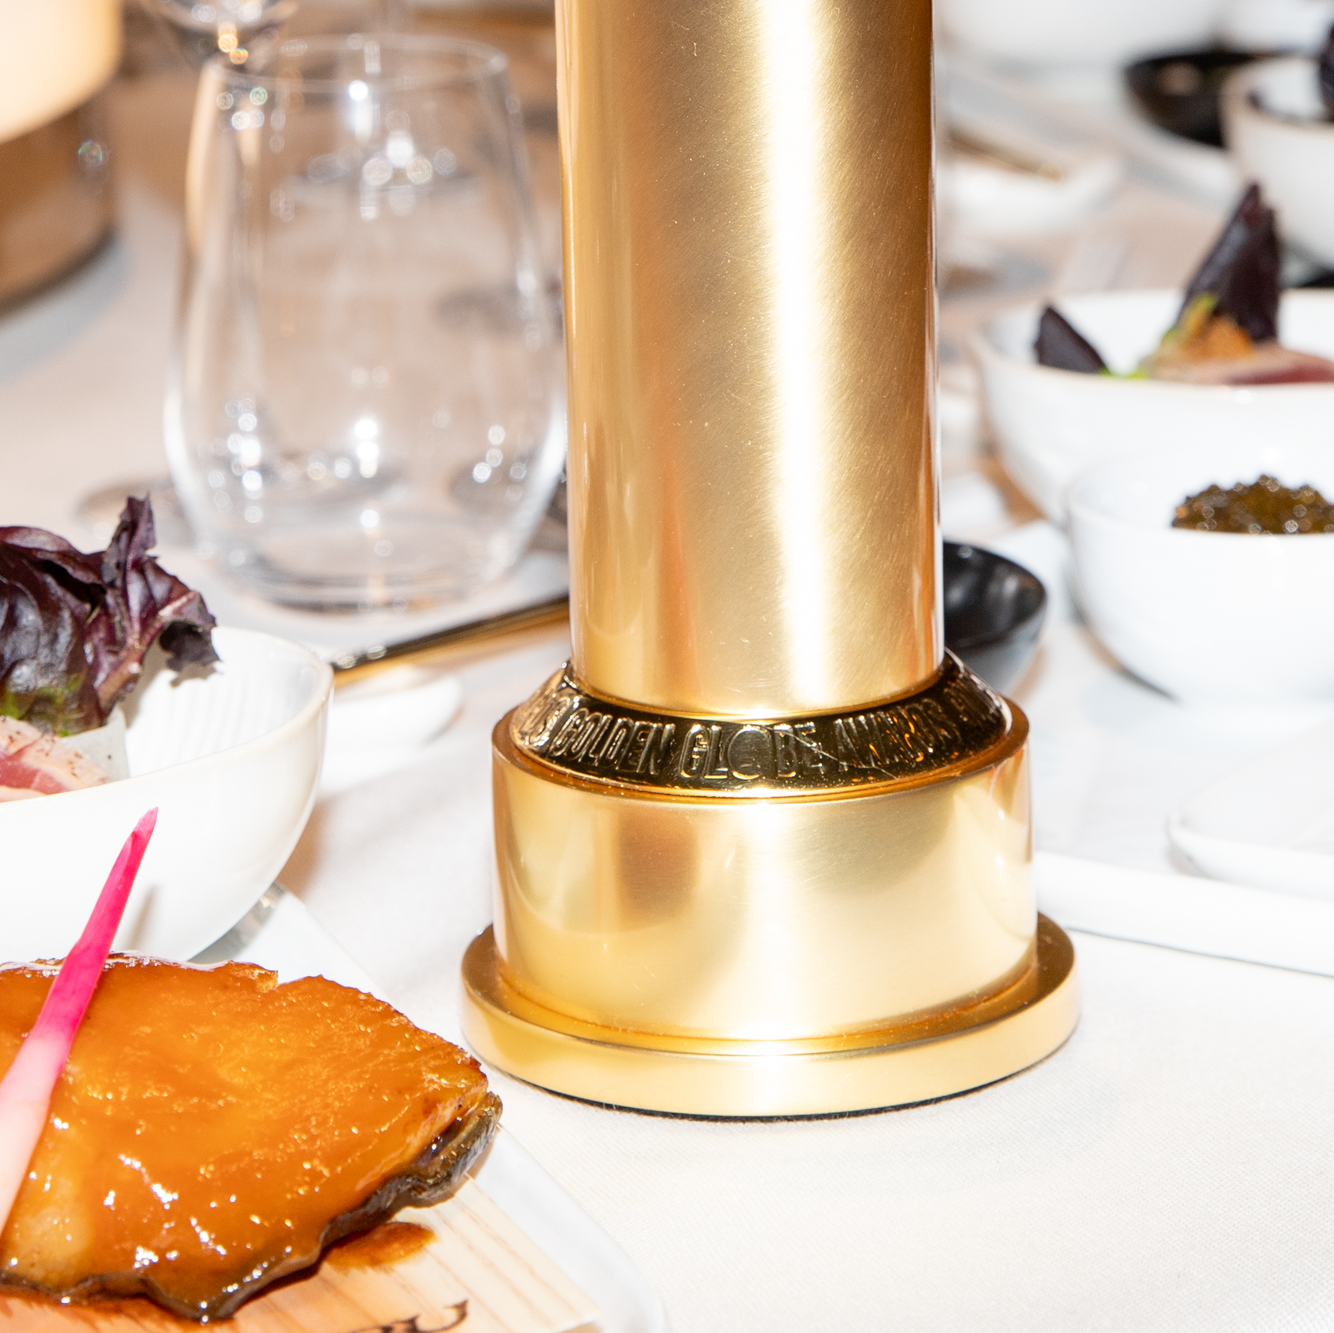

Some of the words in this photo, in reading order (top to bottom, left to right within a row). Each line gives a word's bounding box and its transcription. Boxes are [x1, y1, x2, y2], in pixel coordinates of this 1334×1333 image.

[550, 706, 677, 776] GOLDEN
[677, 722, 824, 781] GLOBE
[832, 697, 964, 773] AWARDS
